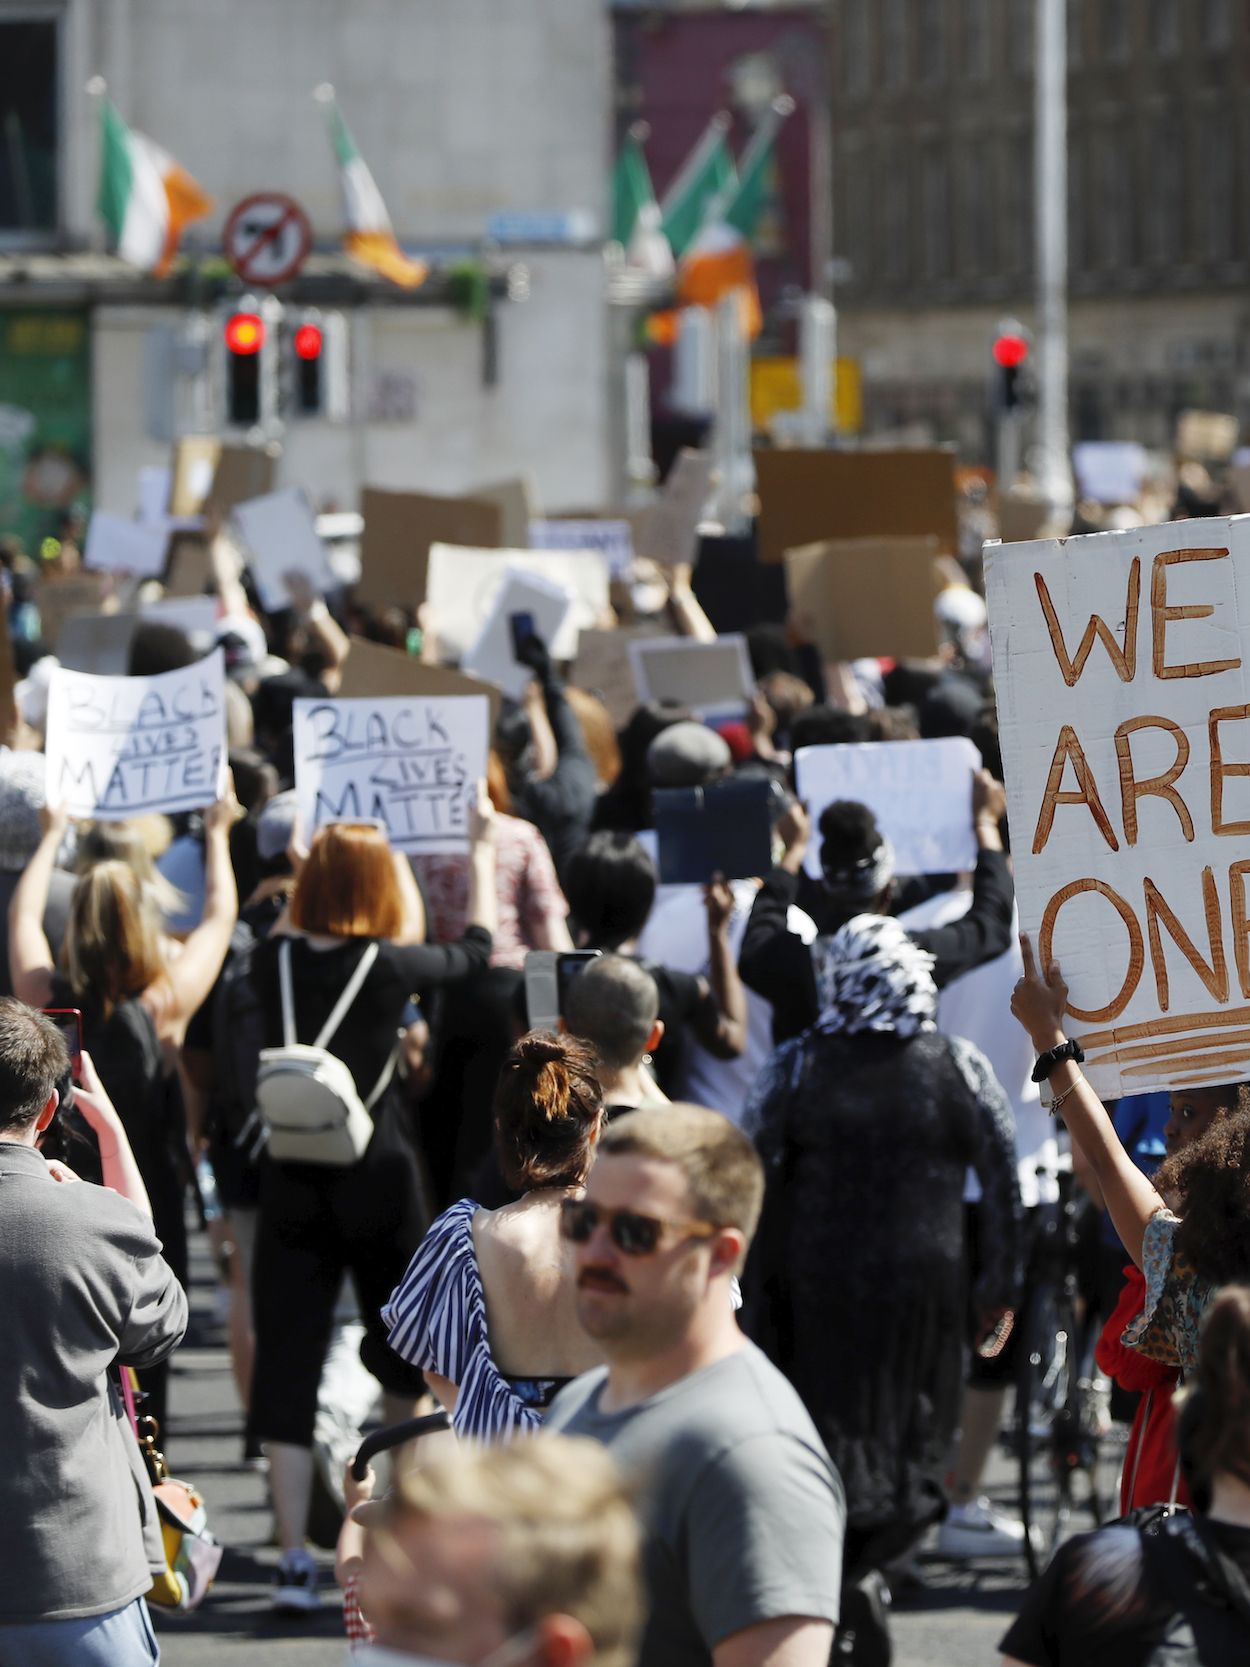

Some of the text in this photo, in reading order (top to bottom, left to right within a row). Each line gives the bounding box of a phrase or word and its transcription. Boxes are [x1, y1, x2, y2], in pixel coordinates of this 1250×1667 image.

[1033, 547, 1242, 687] WE
[66, 681, 218, 729] BLACK
[306, 705, 450, 760] BLACK
[370, 753, 466, 787] LIVES
